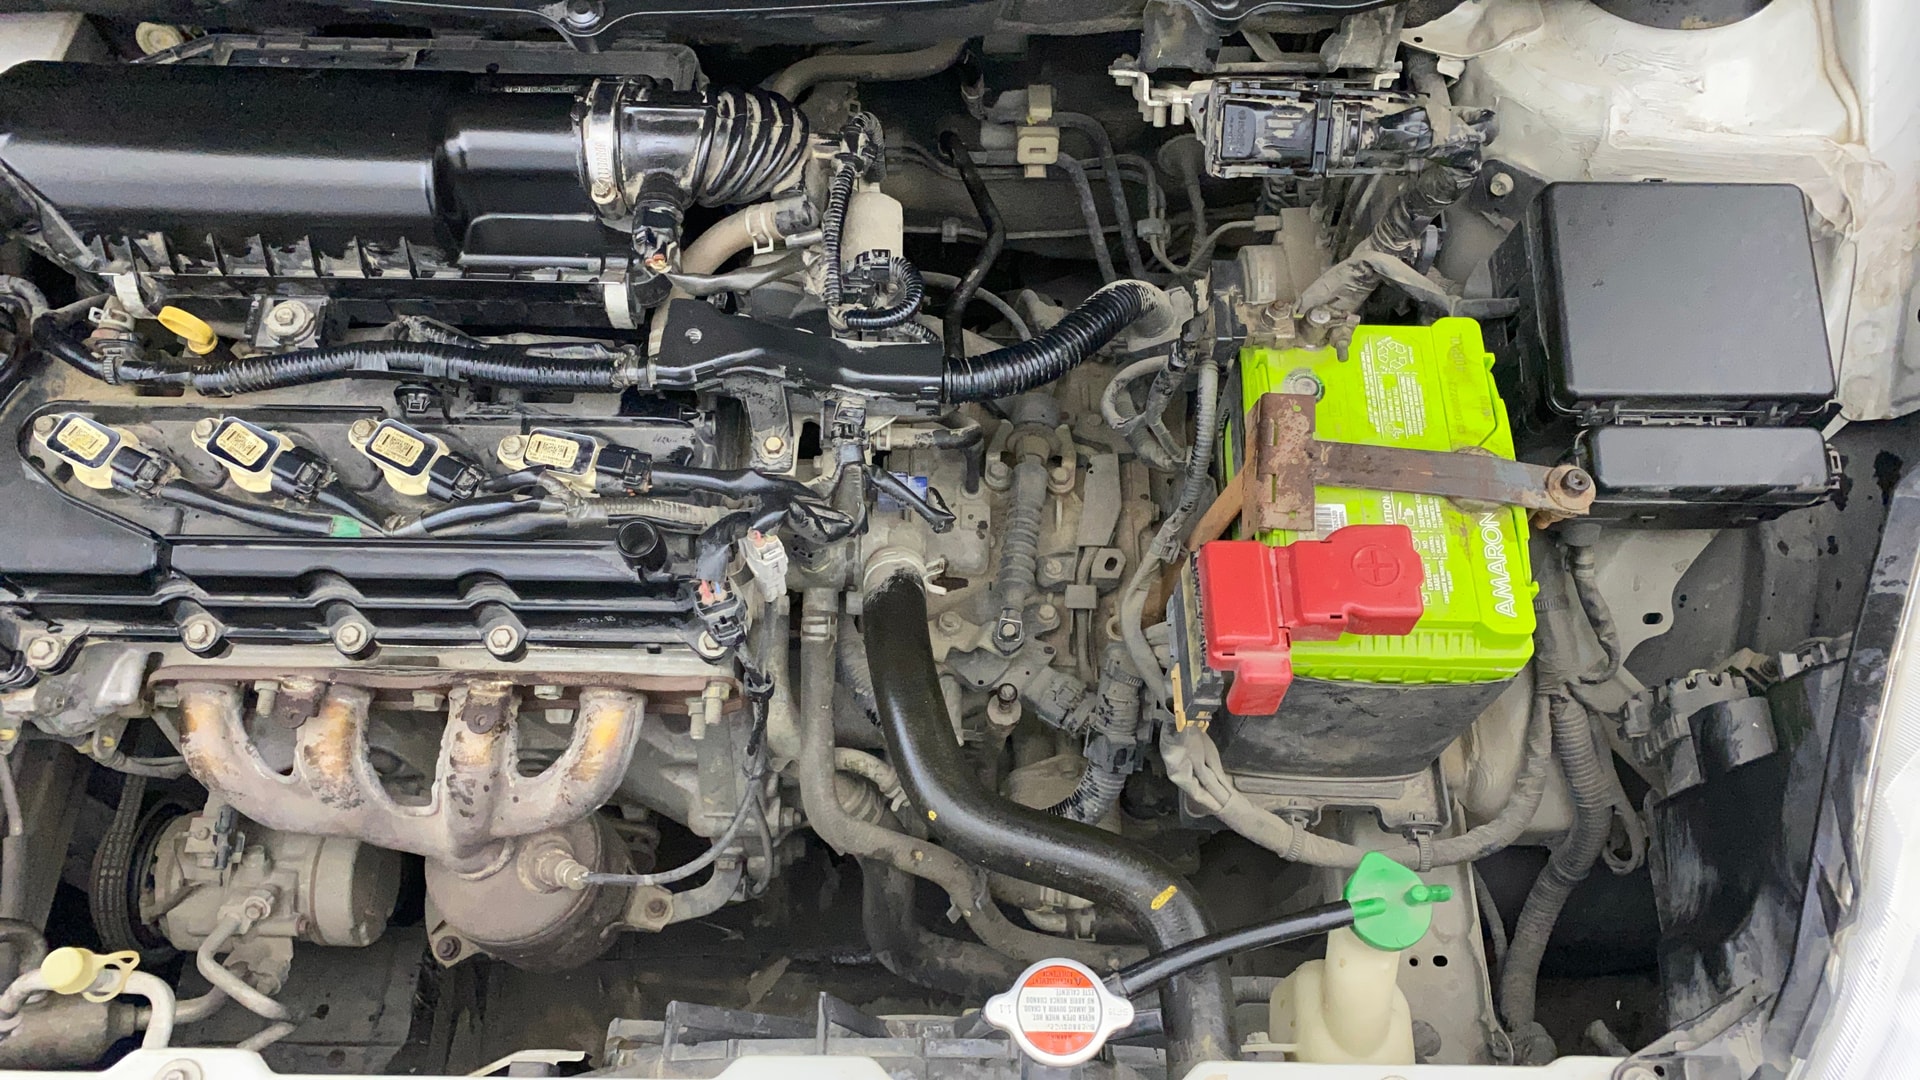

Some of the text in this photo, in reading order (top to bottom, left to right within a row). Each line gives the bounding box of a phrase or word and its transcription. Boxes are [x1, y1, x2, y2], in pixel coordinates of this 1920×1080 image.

[1383, 495, 1393, 524] UTION
[1479, 512, 1517, 617] AMARON
[1045, 1013, 1060, 1021] WHEN
[1062, 1013, 1077, 1021] OPEN
[1079, 1013, 1095, 1021] NEVER
